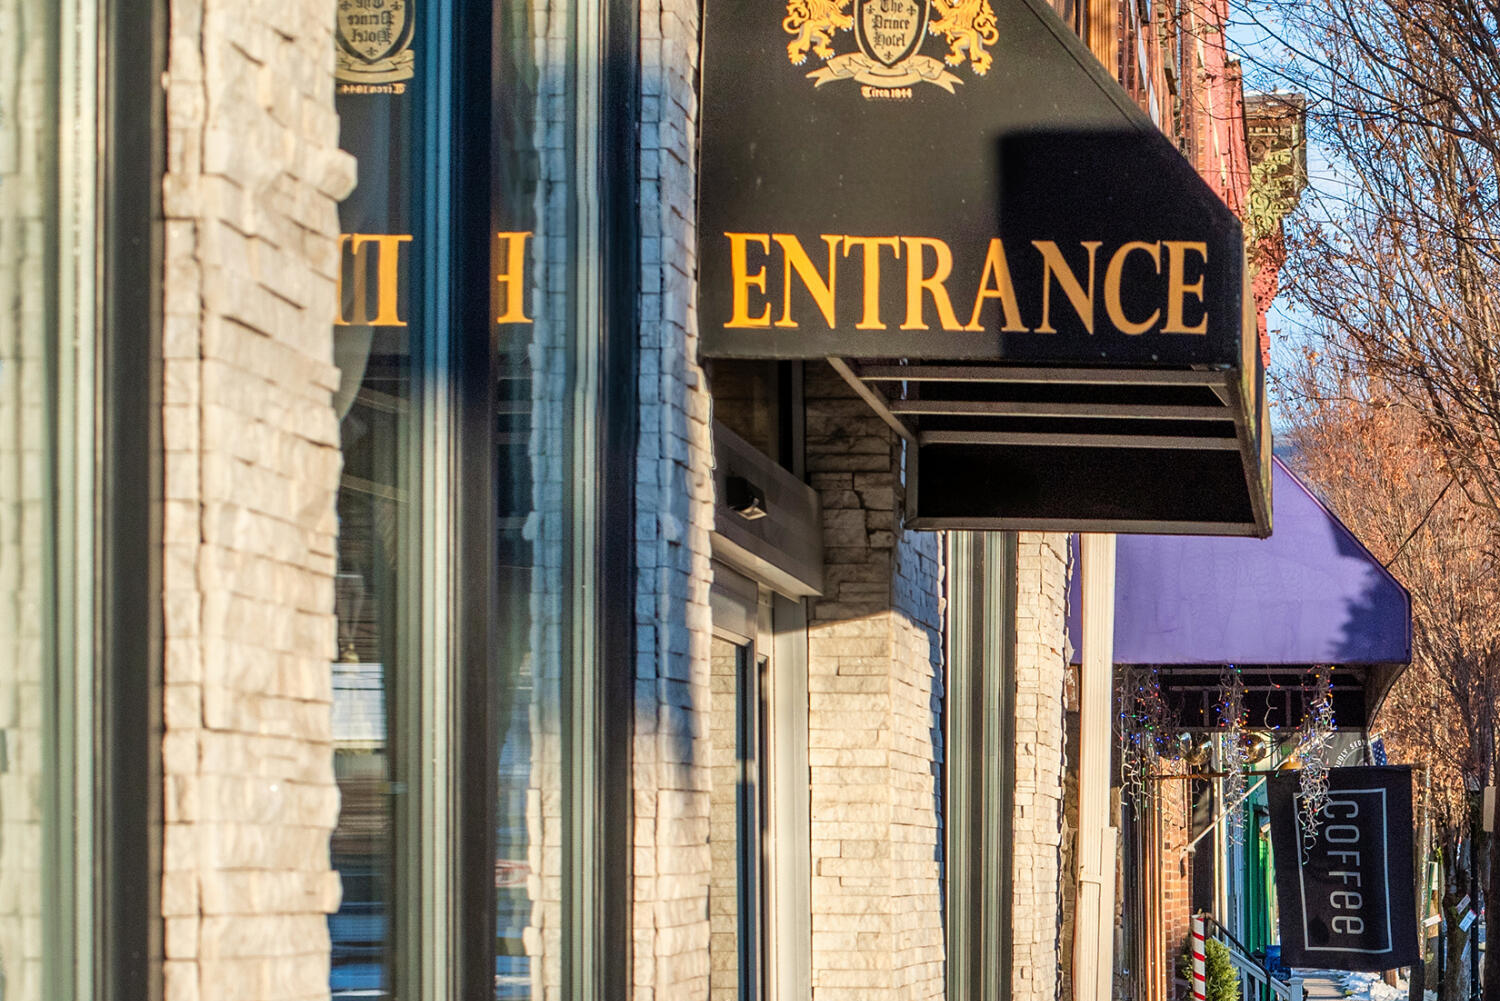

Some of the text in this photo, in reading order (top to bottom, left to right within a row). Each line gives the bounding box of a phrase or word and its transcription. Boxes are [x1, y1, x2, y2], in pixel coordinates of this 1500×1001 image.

[880, 0, 903, 13] The
[872, 14, 910, 30] Prince
[873, 31, 905, 49] Hotel
[861, 86, 889, 98] Circa
[724, 231, 1208, 336] ENTRANCE
